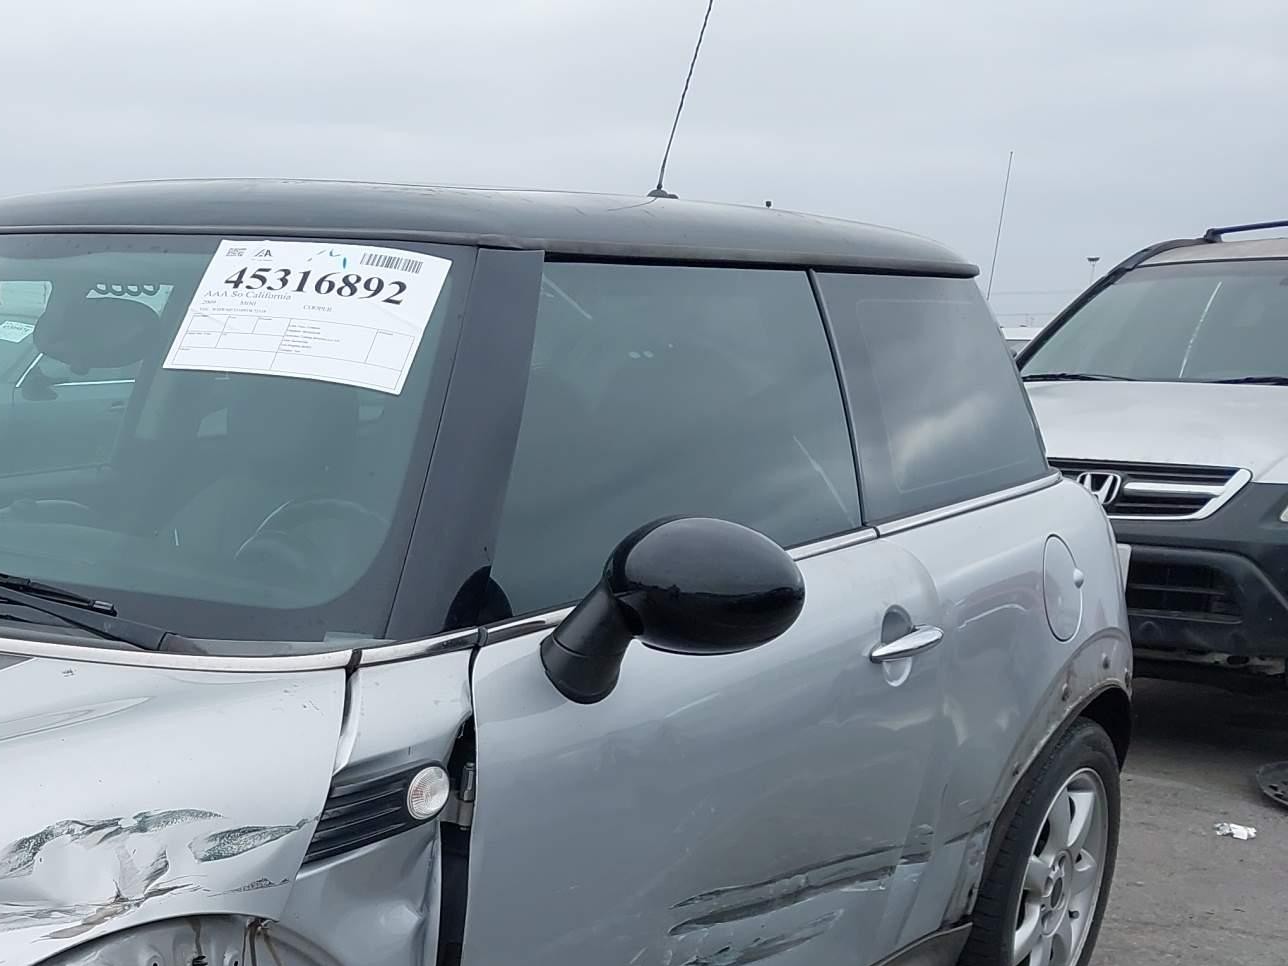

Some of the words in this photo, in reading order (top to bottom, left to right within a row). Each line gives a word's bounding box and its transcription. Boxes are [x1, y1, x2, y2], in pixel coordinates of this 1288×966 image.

[203, 289, 228, 298] AAA
[231, 290, 244, 298] So
[245, 290, 292, 301] California
[223, 266, 408, 305] 45316892
